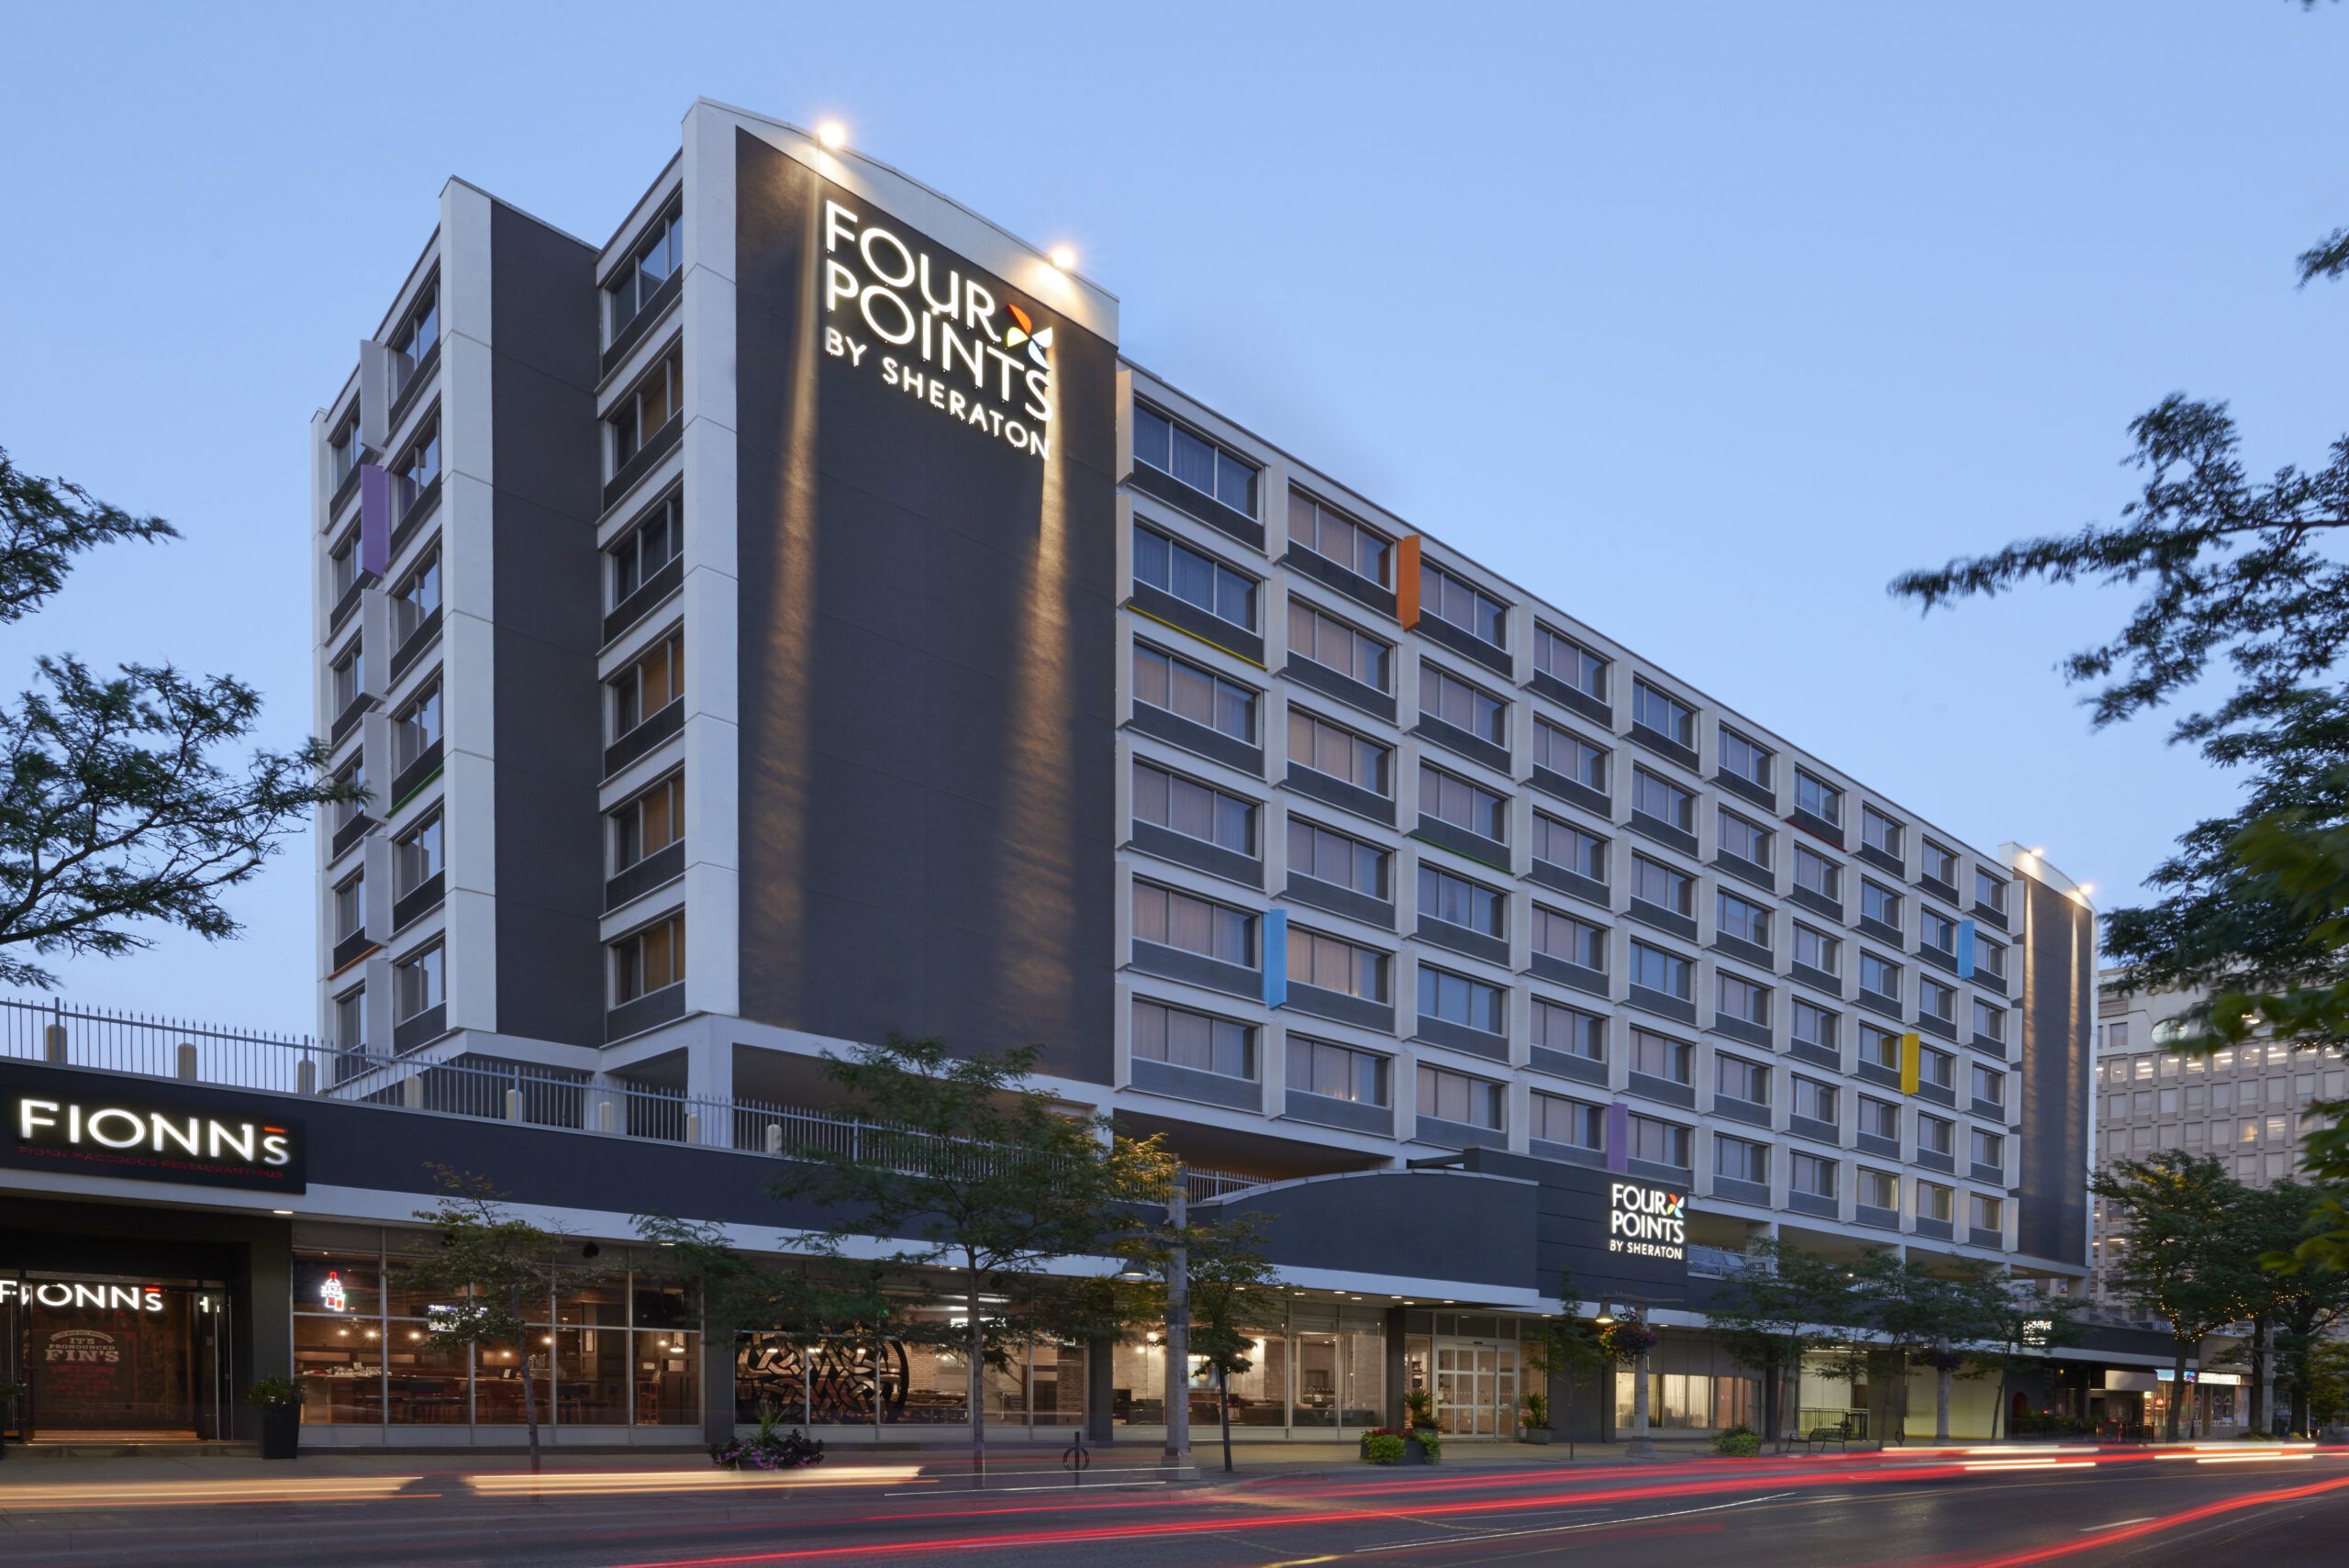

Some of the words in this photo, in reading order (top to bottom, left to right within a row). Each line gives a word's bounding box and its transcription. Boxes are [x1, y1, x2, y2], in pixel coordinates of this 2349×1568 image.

[826, 199, 1002, 342] FOUR
[826, 258, 1053, 422] POINTS
[825, 326, 867, 367] BY
[882, 357, 1051, 462] SHERATON
[1611, 1183, 1667, 1217] FOUR
[1611, 1209, 1685, 1245] POINTS
[1609, 1239, 1623, 1252] BY
[1627, 1241, 1683, 1260] SHERATON
[44, 1349, 120, 1362] FIN'S
[69, 1337, 95, 1345] IT'S
